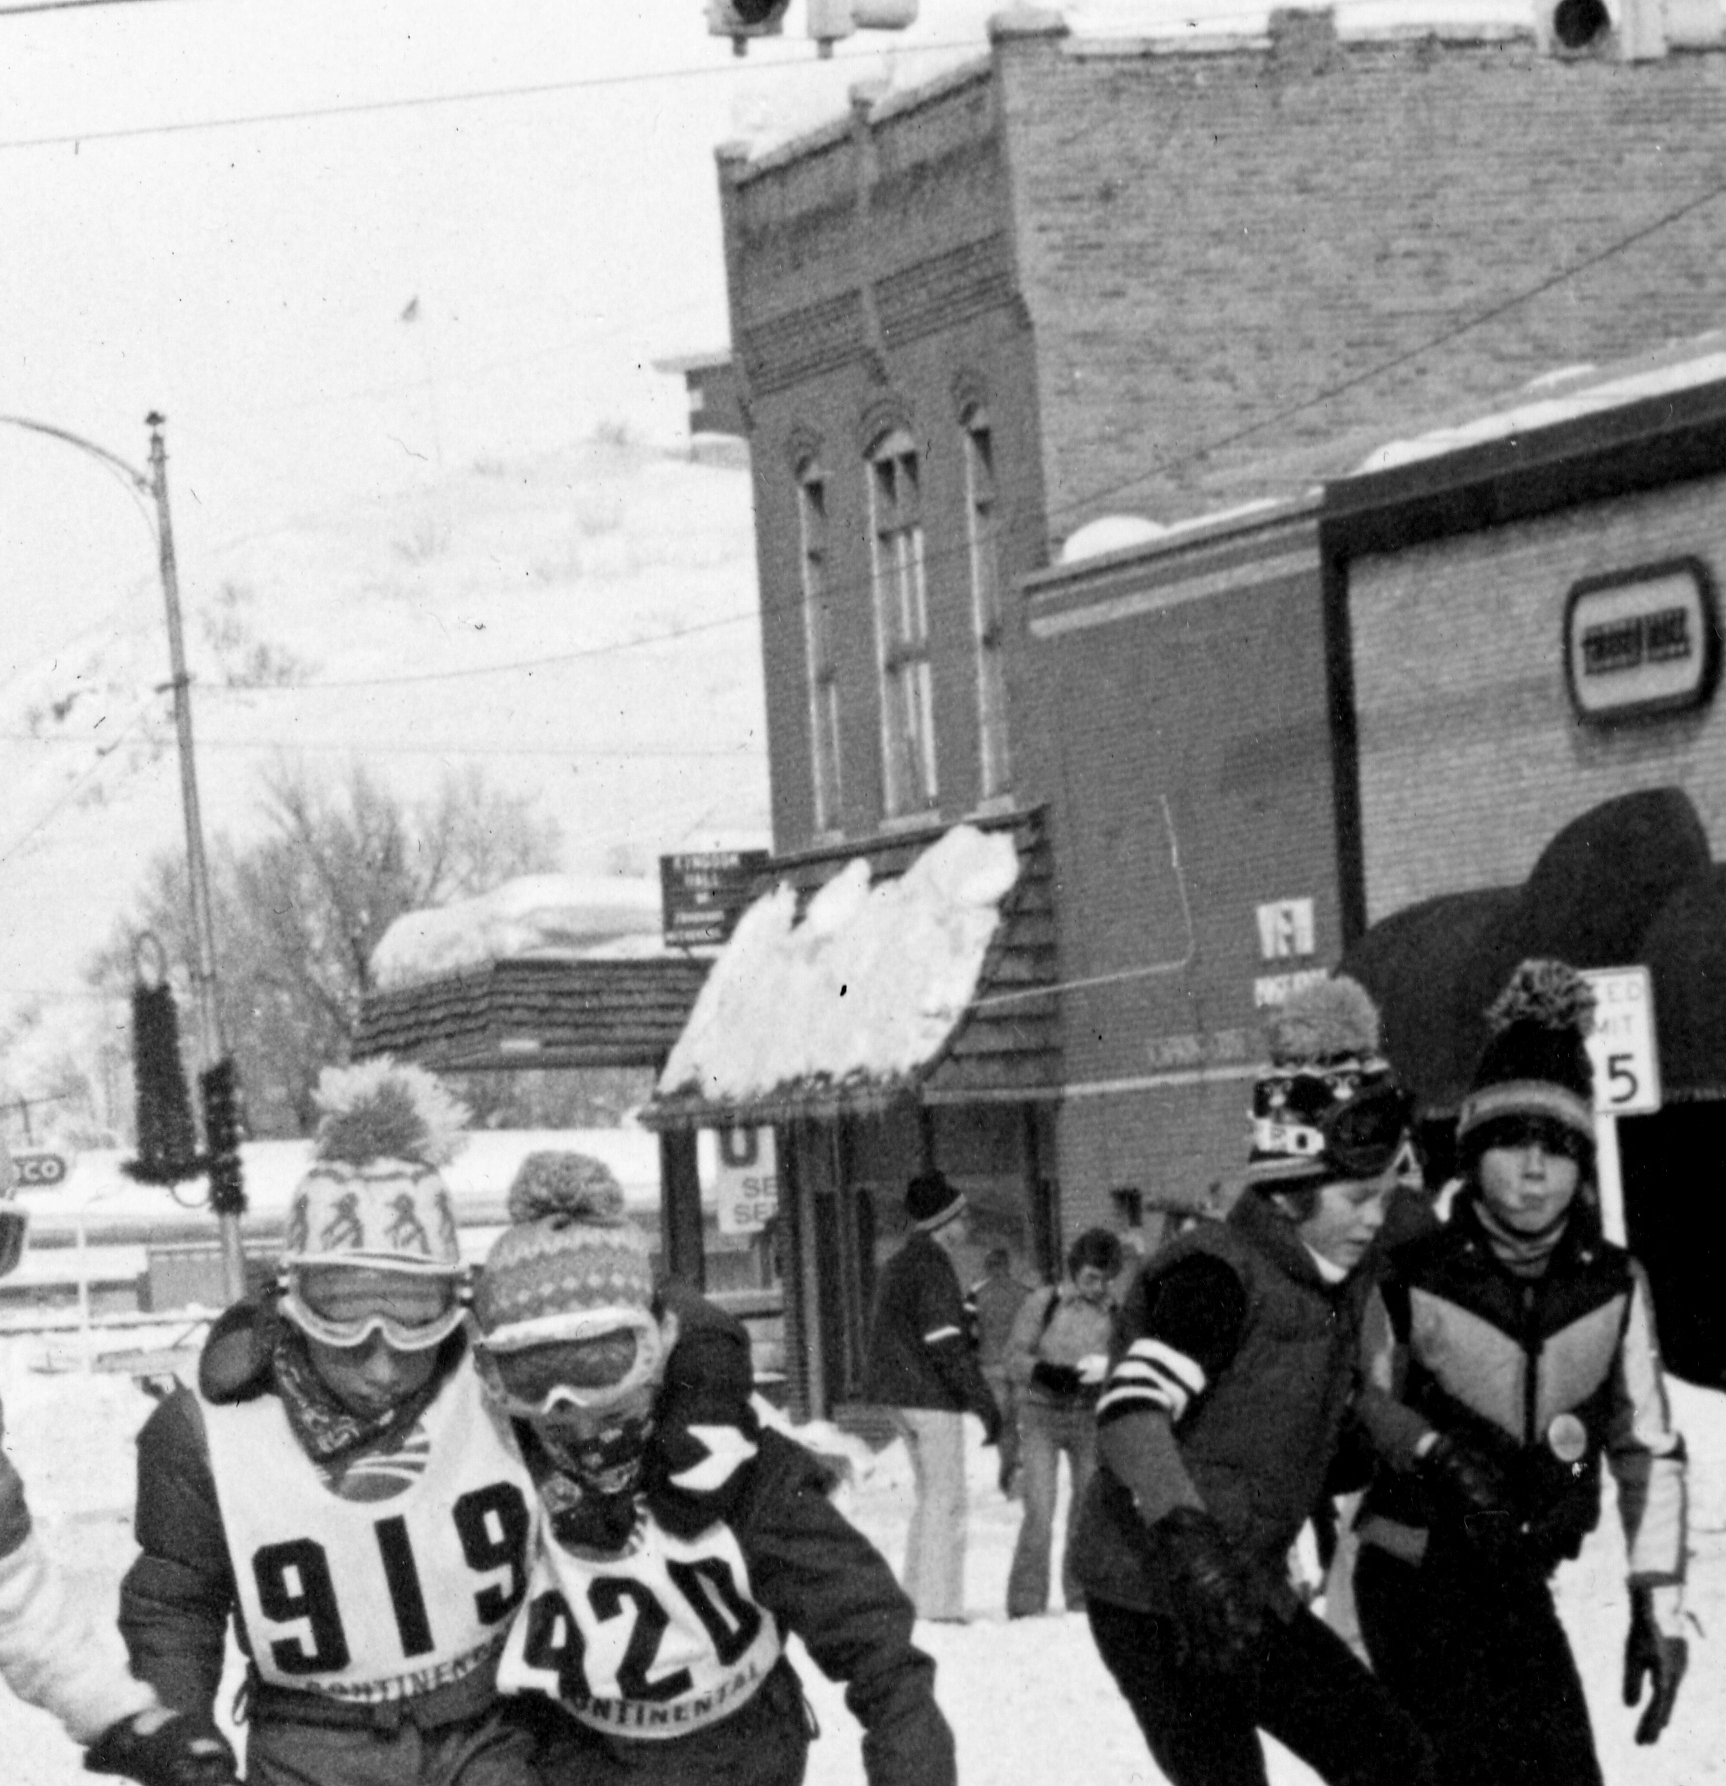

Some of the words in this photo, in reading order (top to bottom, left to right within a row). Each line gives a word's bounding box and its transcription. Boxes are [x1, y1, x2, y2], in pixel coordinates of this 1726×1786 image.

[1595, 1013, 1634, 1035] MIT
[1607, 1053, 1639, 1103] 5
[733, 1203, 776, 1225] SE
[251, 1481, 531, 1675] 919
